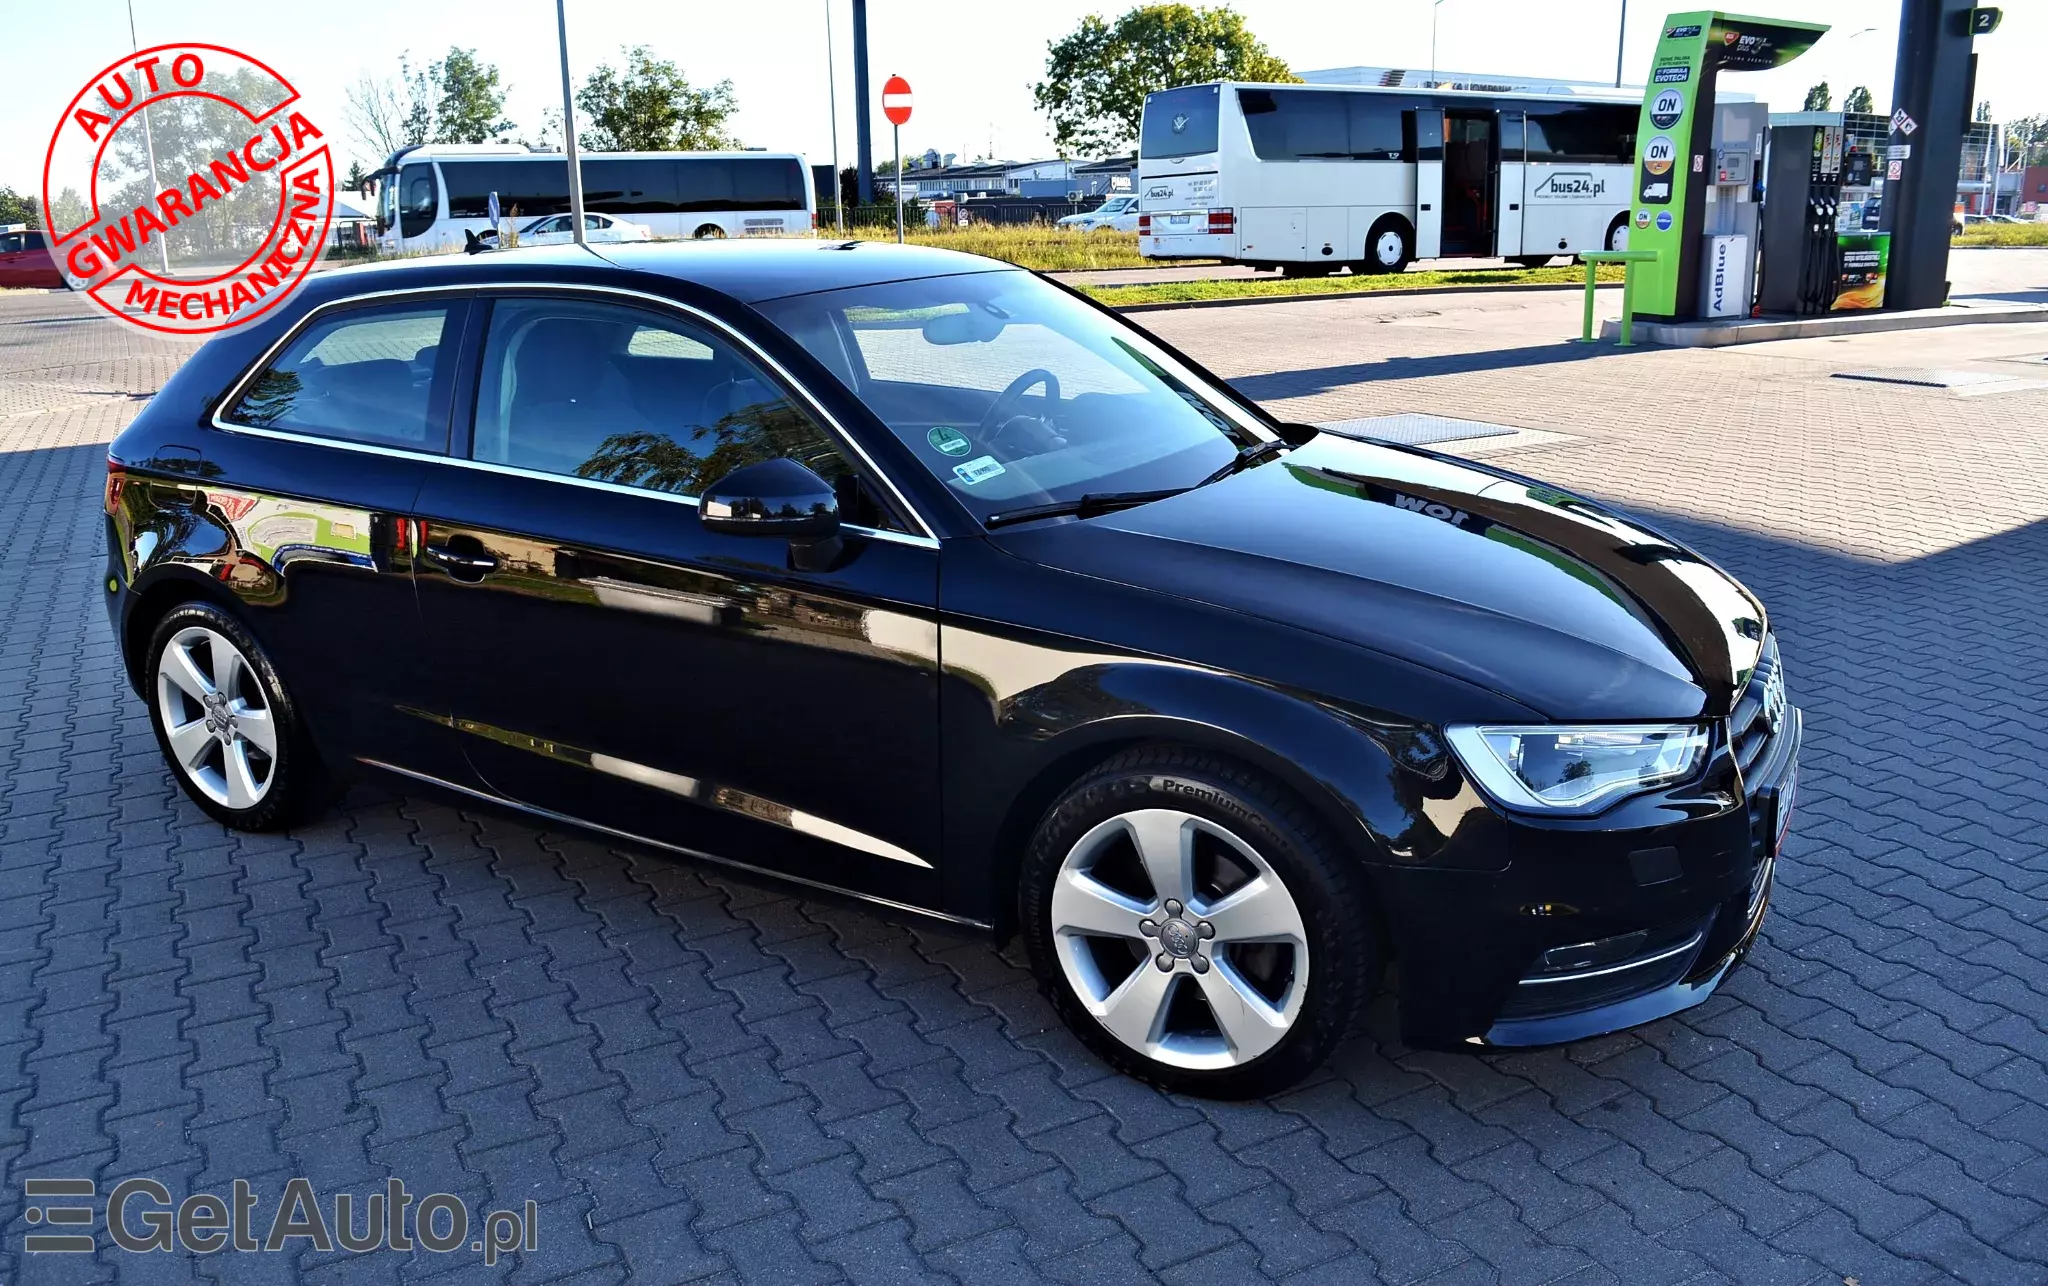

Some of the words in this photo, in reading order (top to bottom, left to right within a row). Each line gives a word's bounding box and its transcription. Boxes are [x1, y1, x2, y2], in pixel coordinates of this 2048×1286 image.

[1979, 14, 1989, 26] 2
[1739, 35, 1755, 45] EVO
[1654, 74, 1687, 82] EVOTECH
[1658, 98, 1677, 112] ON
[1650, 145, 1669, 158] ON
[1150, 189, 1174, 199] bus24.pl
[1550, 178, 1605, 198] bus24.pl
[1713, 244, 1727, 312] AdBlue
